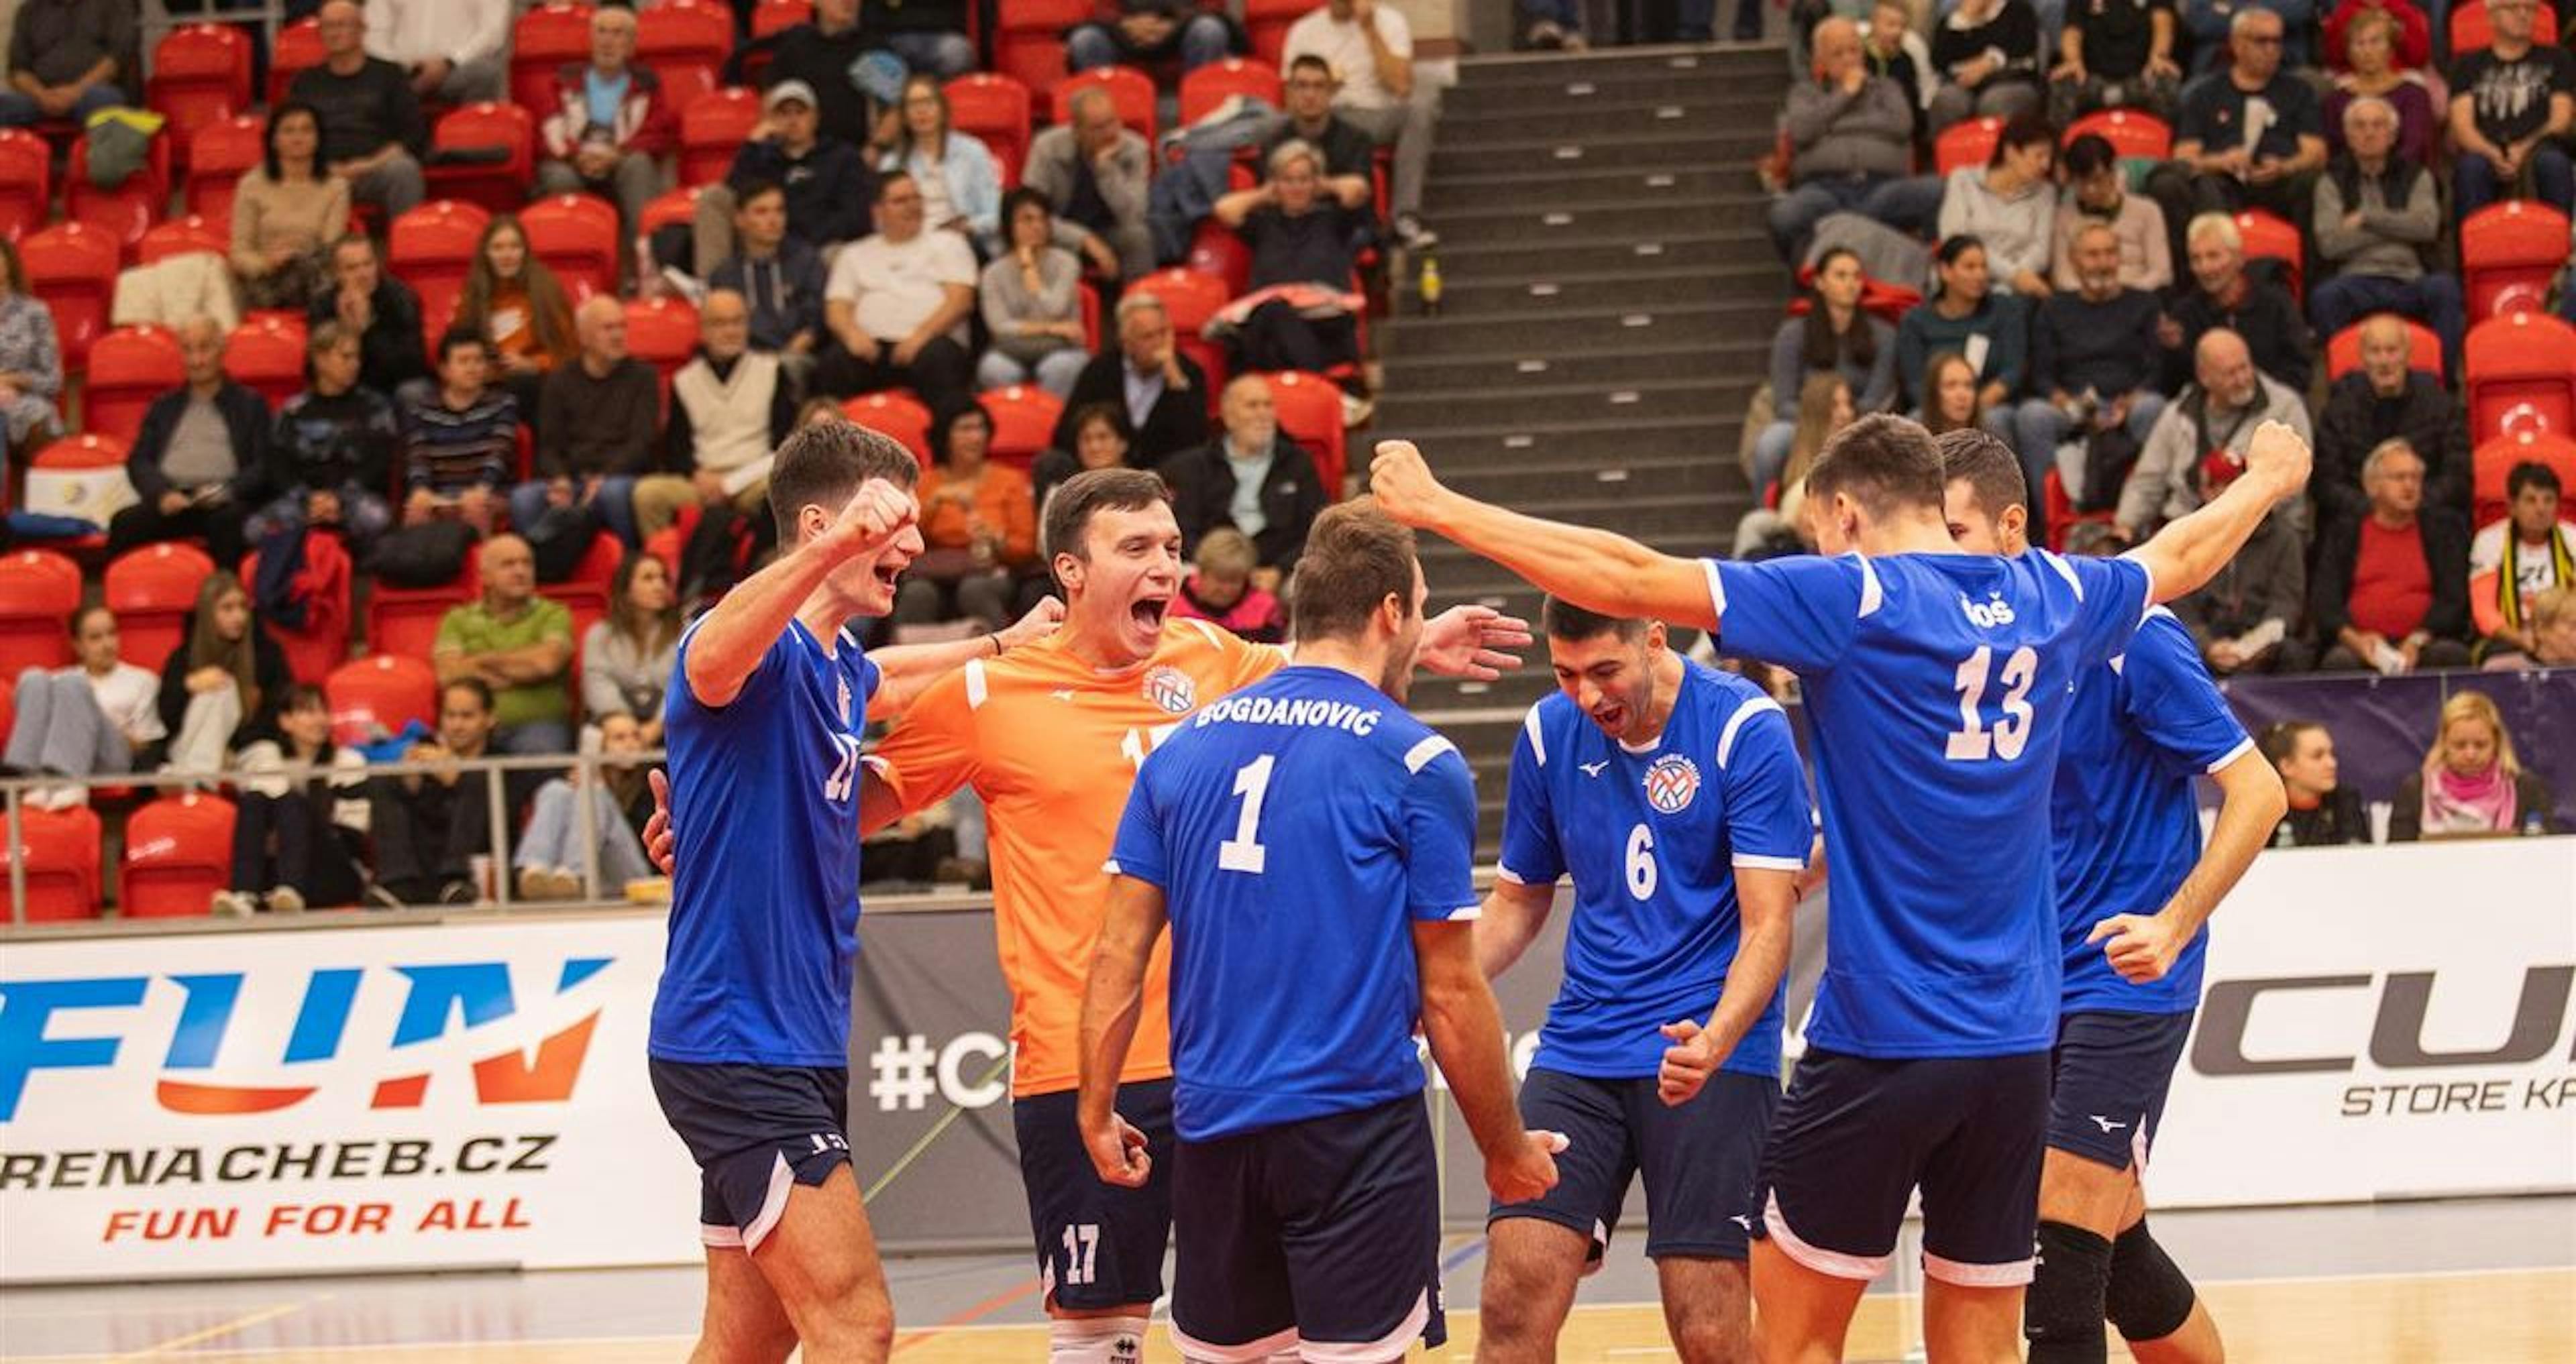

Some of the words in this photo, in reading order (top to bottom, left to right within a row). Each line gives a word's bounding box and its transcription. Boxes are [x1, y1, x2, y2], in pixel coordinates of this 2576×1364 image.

[1946, 645, 2038, 760] 13
[1218, 754, 1275, 873] 1
[1624, 823, 1658, 901] 6
[0, 957, 616, 1121] FUN
[2191, 964, 2576, 1077] CU
[869, 1031, 1019, 1111] #C
[2341, 1080, 2512, 1116] STORE
[103, 1208, 239, 1242] FUN
[264, 1204, 392, 1238] FOR
[418, 1198, 533, 1231] ALL
[1061, 1223, 1100, 1285] 17
